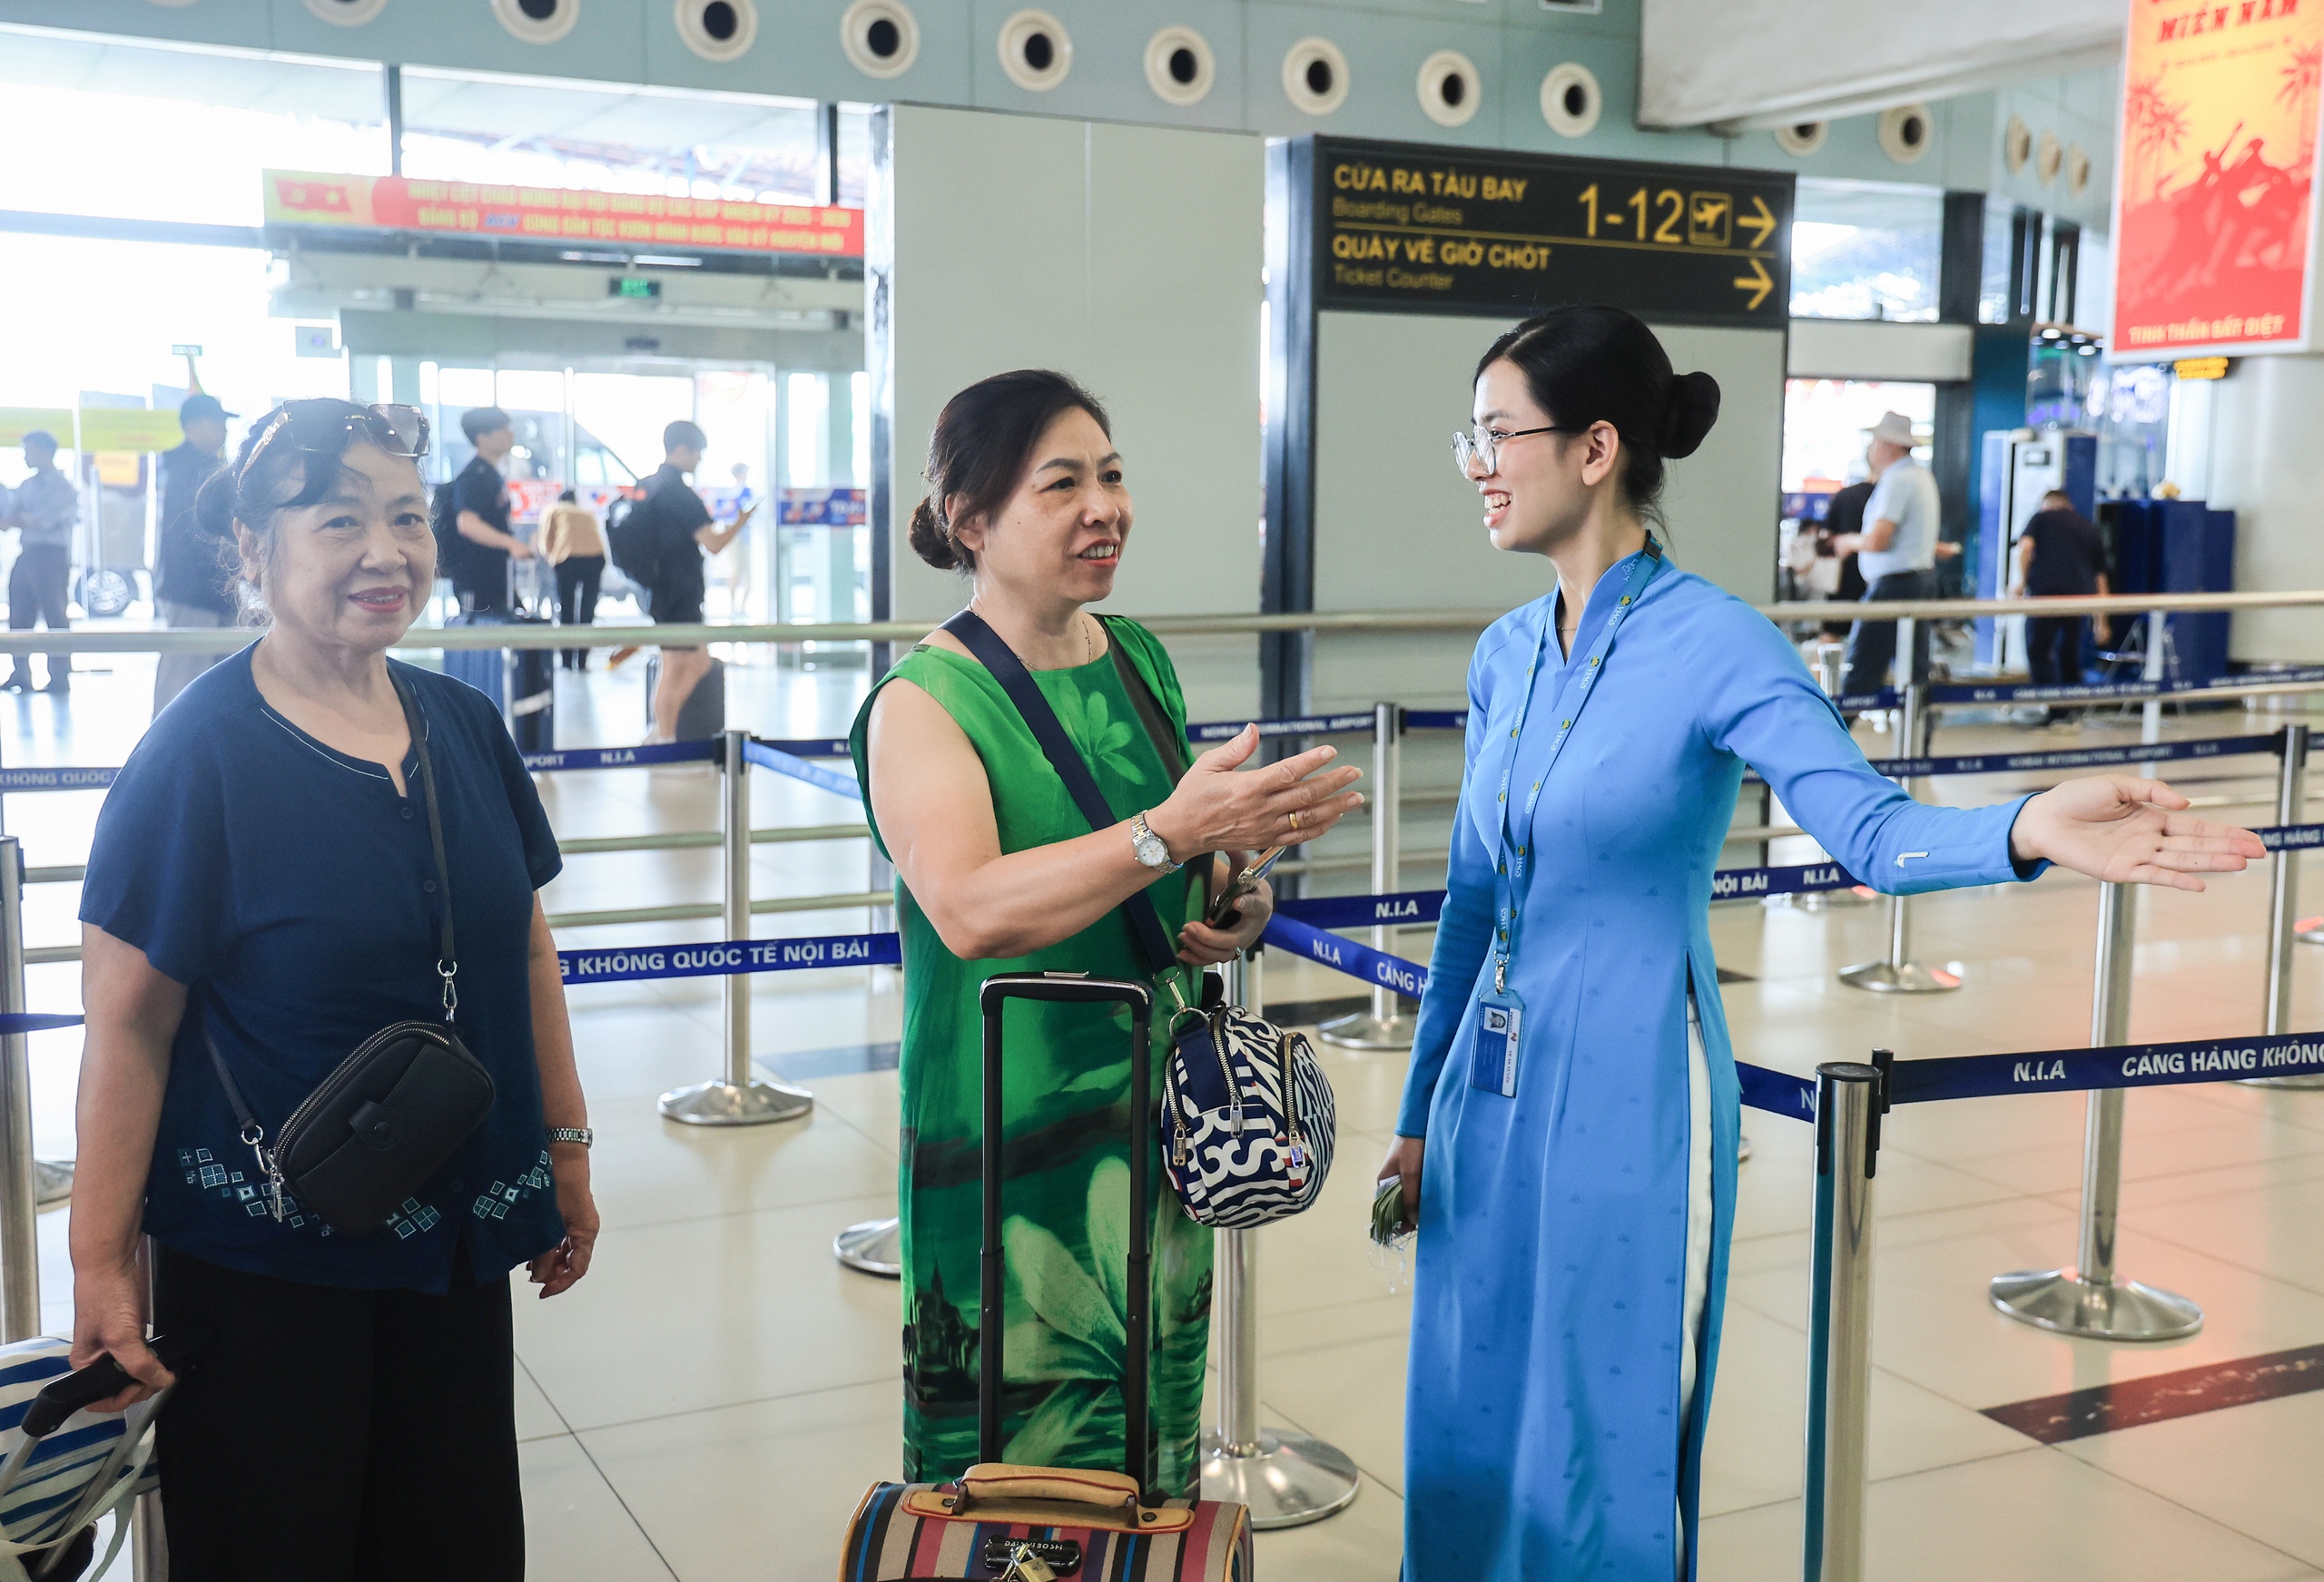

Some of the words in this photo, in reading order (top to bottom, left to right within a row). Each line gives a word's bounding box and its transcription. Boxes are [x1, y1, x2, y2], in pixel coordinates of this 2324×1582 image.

[1334, 162, 1387, 192] CỬA
[1393, 168, 1426, 195] RA
[1431, 166, 1477, 199] TÀU
[1482, 175, 1528, 201] BAY
[1333, 195, 1410, 225] Boarding
[1413, 201, 1463, 224] Gates
[1578, 182, 1684, 243] 1-12
[1404, 235, 1435, 263] VÉ
[1441, 238, 1485, 266] GIỜ
[1488, 241, 1551, 270] CHÓT
[1333, 263, 1384, 286] Ticket
[1386, 267, 1453, 290] Counter
[1580, 668, 1594, 690] VIAGS
[1551, 730, 1565, 752] VIAGS
[600, 751, 635, 763] N.I.A
[1500, 769, 1509, 791] VIAGS
[1525, 792, 1536, 815] VIAGS
[1741, 871, 1768, 891] BÀI
[1803, 868, 1840, 885] N.I.A
[1375, 899, 1419, 919] N.I.A
[1501, 908, 1509, 930] VIAGS
[578, 951, 665, 975] KHÔNG
[673, 941, 742, 968] QUỐC
[750, 940, 779, 964] TẾ
[784, 939, 824, 966] NỘI
[832, 938, 869, 959] BÀI
[1314, 939, 1342, 966] N.I.A
[1377, 960, 1414, 991] CẢNG
[2014, 1059, 2065, 1082] N.I.A
[2122, 1047, 2185, 1076] CẢNG
[2191, 1046, 2256, 1072] HÀNG
